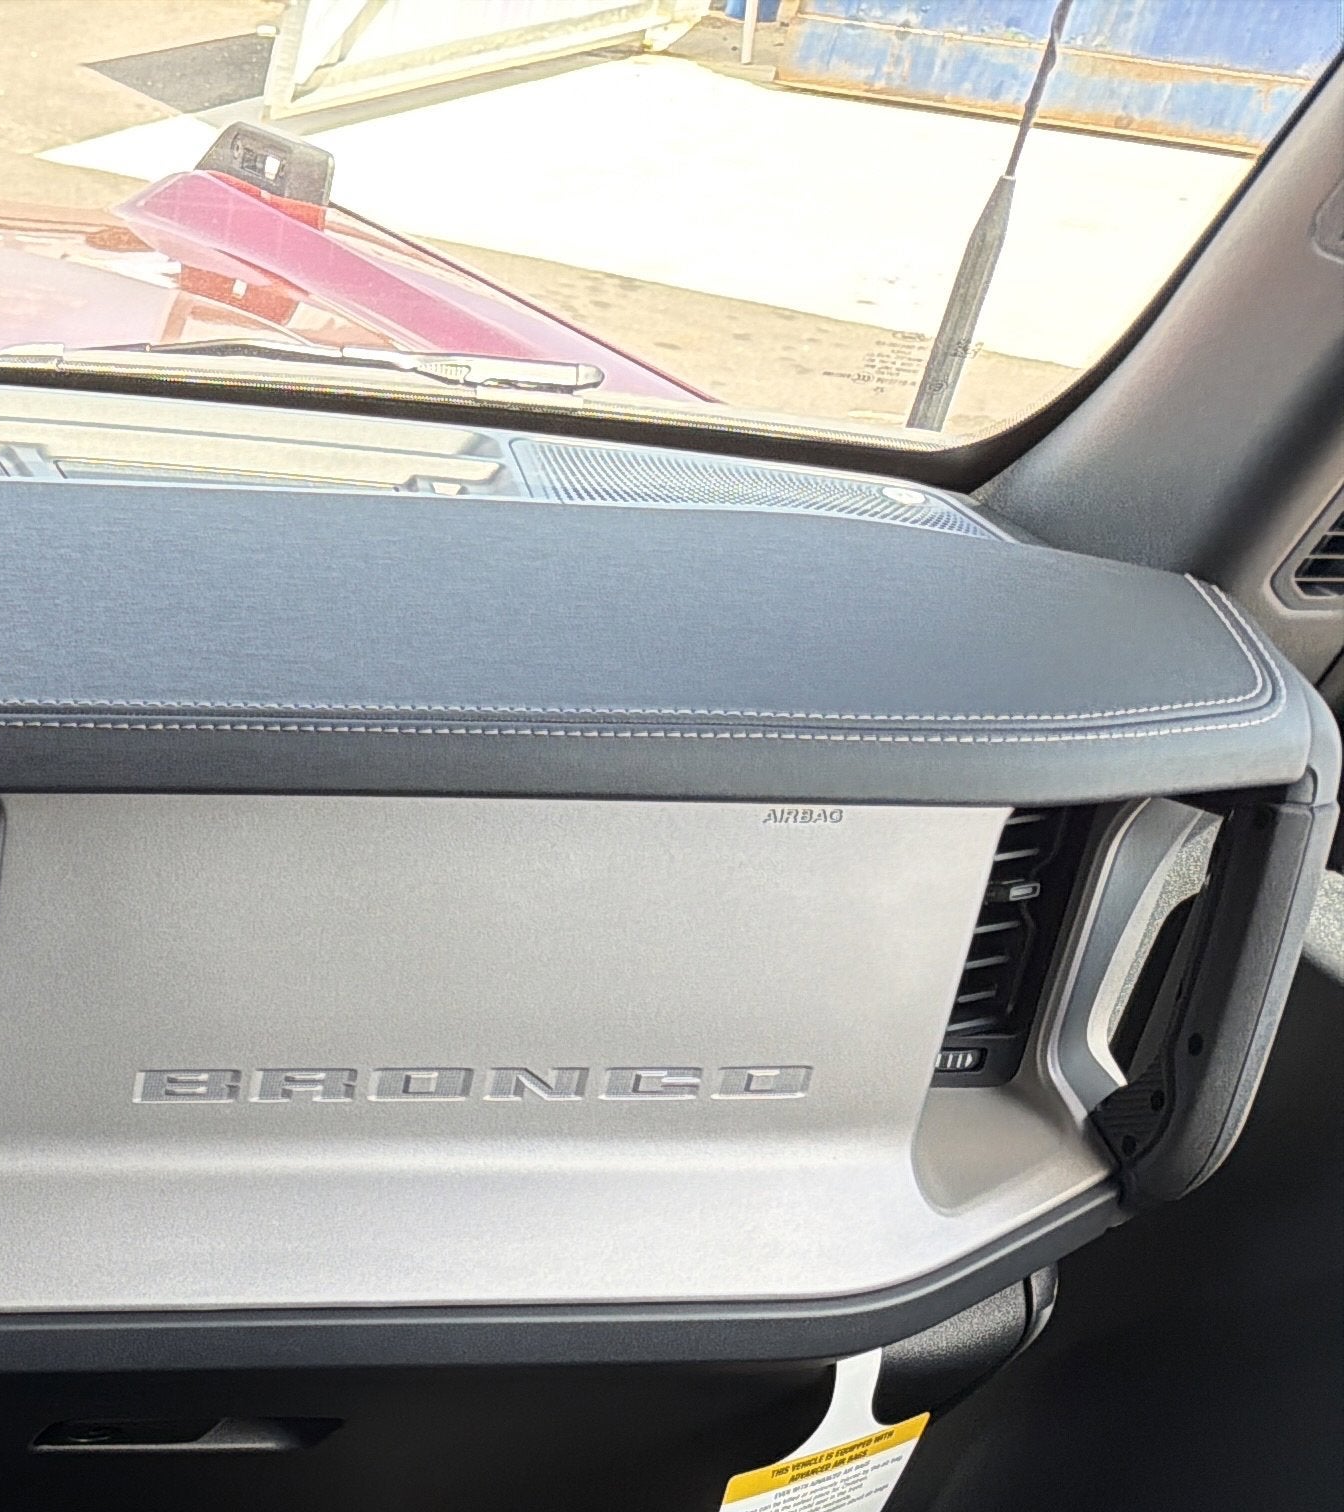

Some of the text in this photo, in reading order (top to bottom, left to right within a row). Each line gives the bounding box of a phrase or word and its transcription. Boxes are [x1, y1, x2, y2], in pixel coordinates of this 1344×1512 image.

[762, 808, 844, 824] AIRBAG
[132, 1065, 814, 1105] BRONCO
[771, 1466, 789, 1477] THIS
[792, 1455, 824, 1470] VEHICLE
[836, 1439, 872, 1456] EQUIPPED
[874, 1431, 893, 1442] WITH
[790, 1464, 831, 1482] ADVANCED
[833, 1458, 848, 1467] AIR
